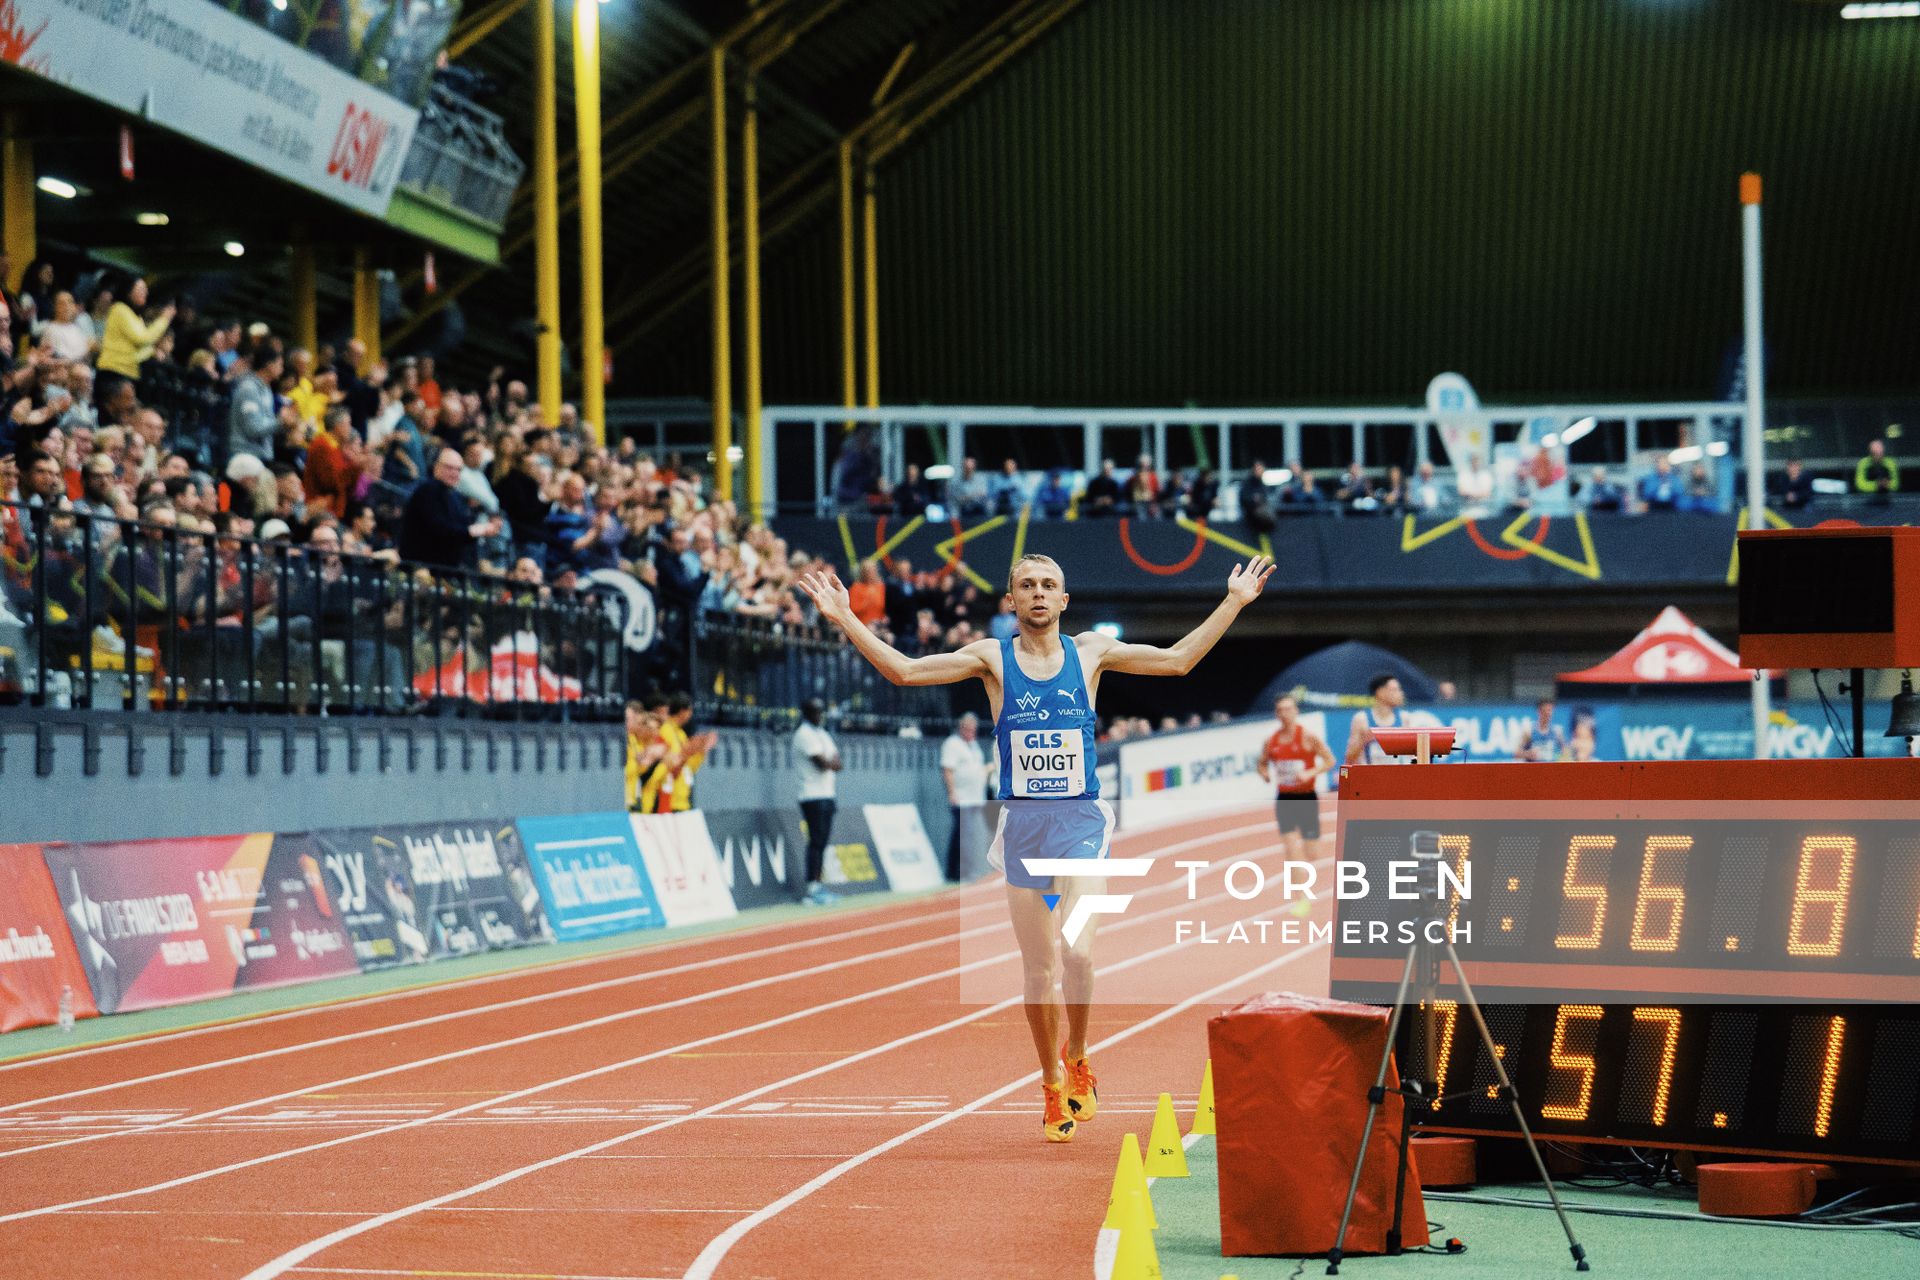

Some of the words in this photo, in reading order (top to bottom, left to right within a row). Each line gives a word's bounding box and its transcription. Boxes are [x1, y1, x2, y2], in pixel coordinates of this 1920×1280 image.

[1058, 708, 1086, 716] VIACTIV
[1019, 754, 1077, 771] VOIGT
[1043, 780, 1067, 788] PLAN
